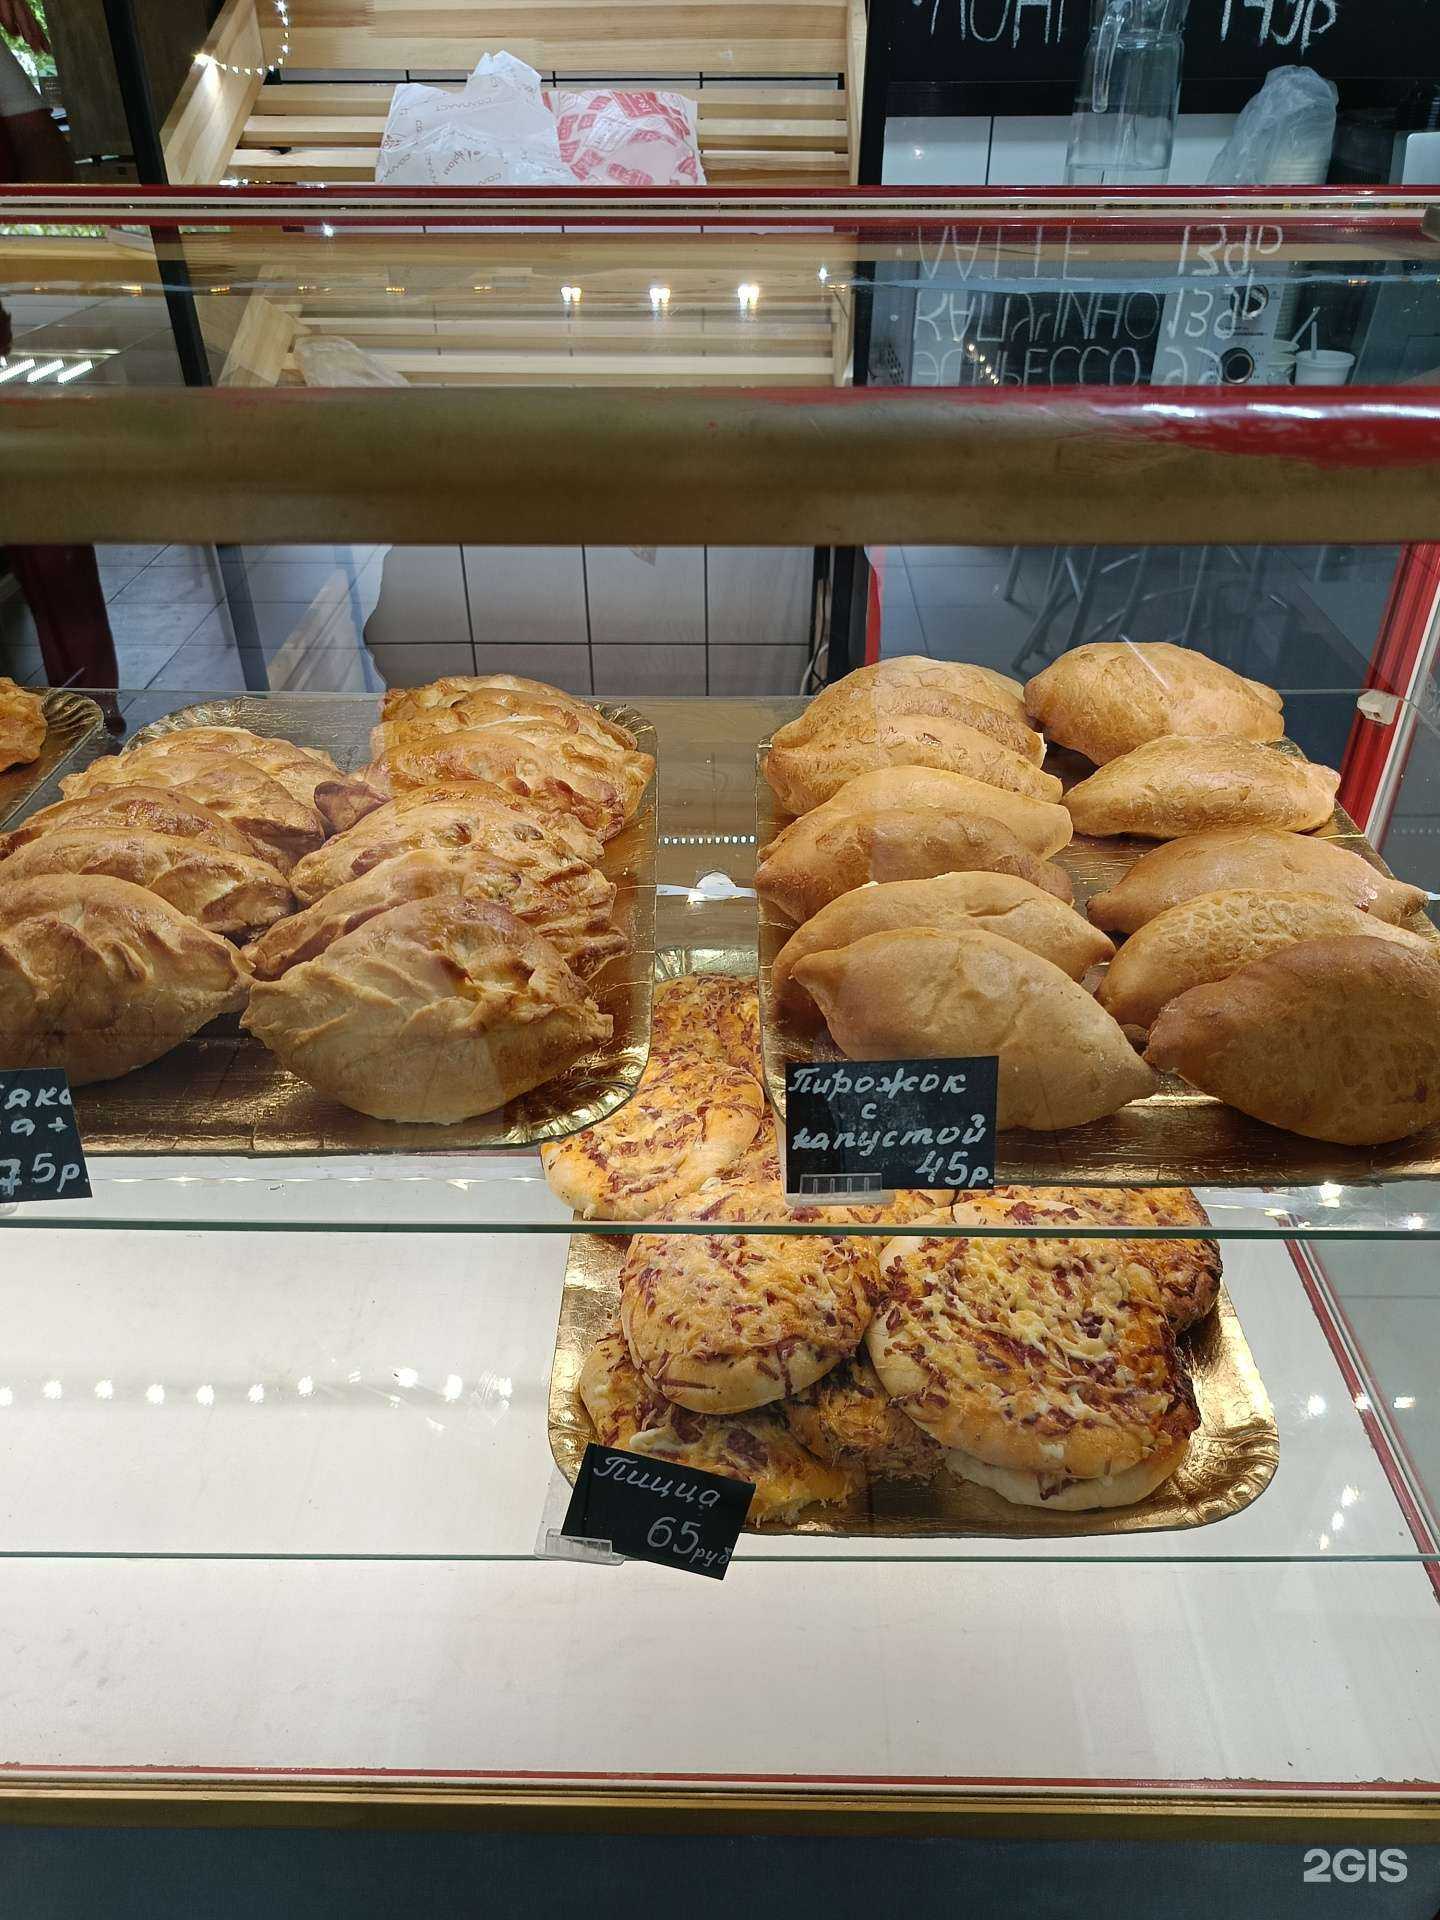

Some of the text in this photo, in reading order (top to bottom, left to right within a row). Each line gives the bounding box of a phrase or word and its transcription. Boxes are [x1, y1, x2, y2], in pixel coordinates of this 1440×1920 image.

[788, 1068, 967, 1101] Пирожок
[860, 1102, 878, 1120] с
[792, 1114, 987, 1157] капустой
[593, 1456, 721, 1507] Пицца
